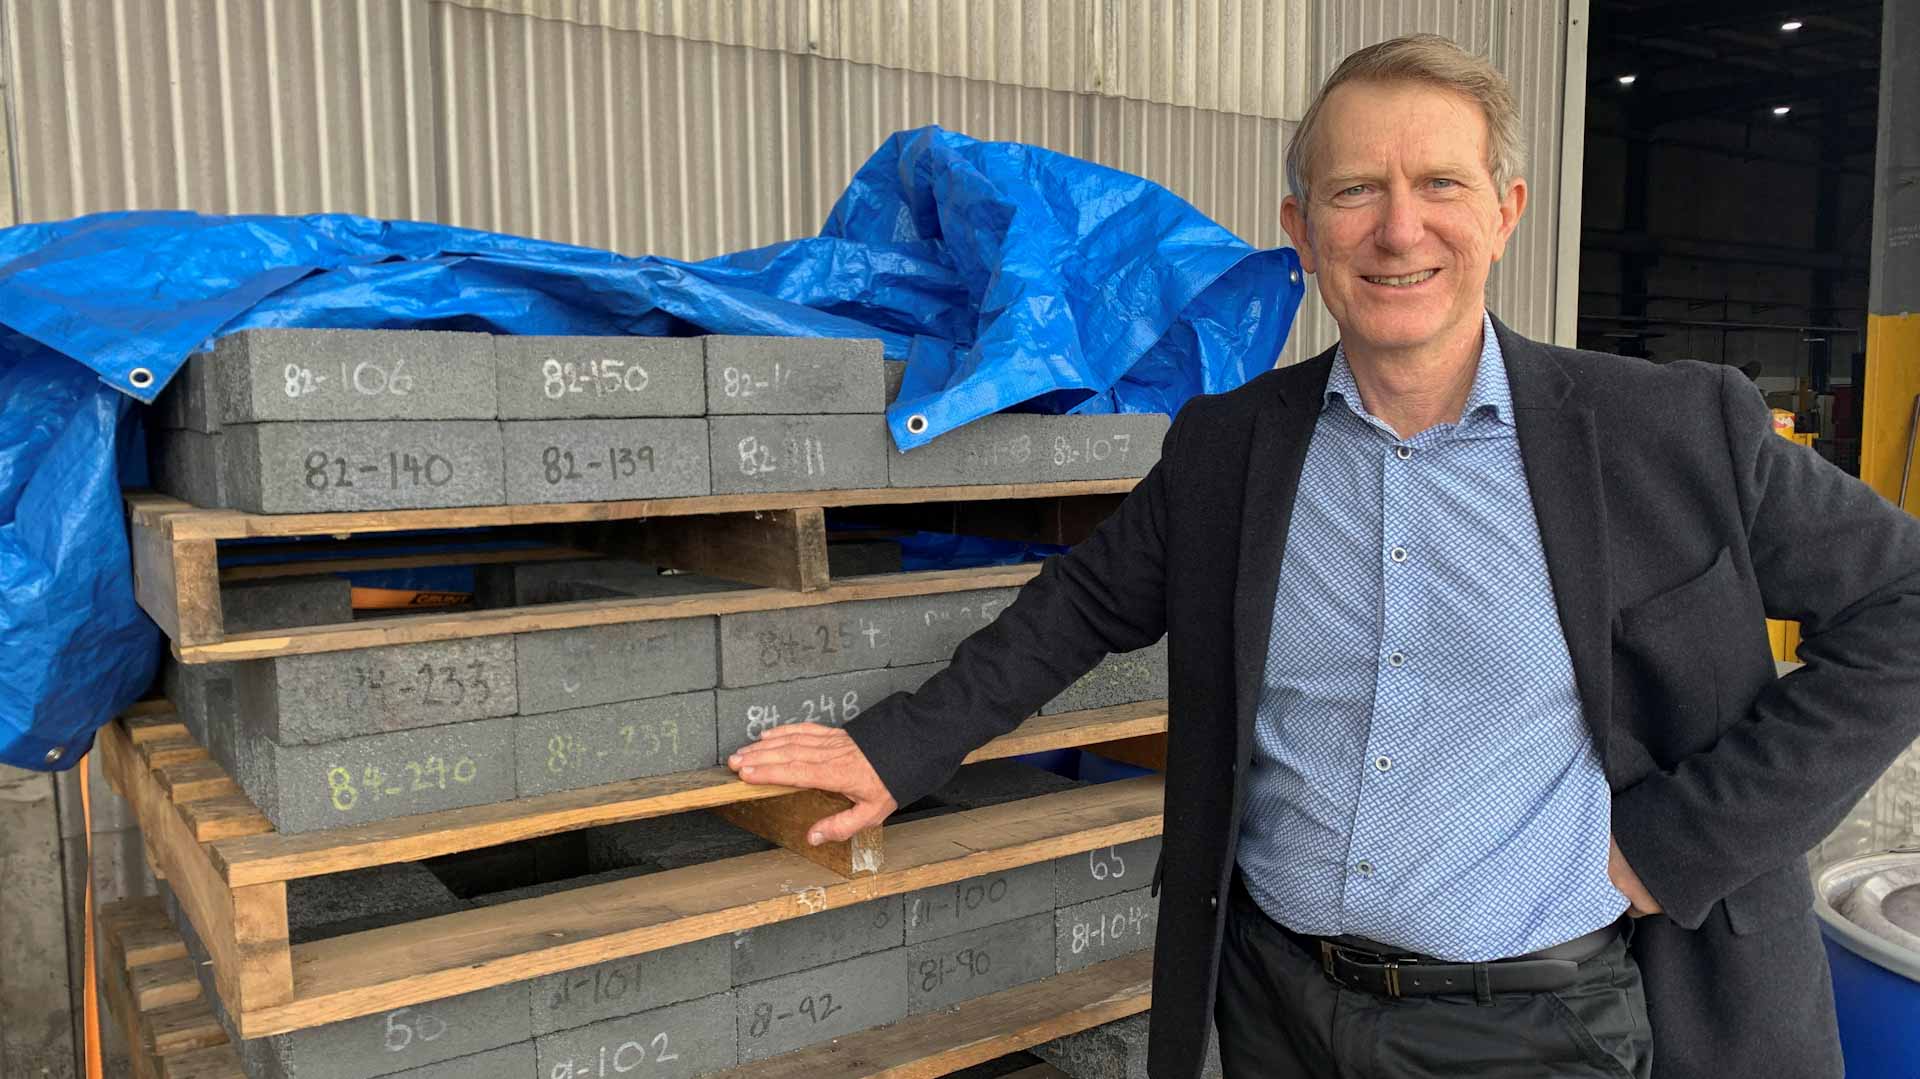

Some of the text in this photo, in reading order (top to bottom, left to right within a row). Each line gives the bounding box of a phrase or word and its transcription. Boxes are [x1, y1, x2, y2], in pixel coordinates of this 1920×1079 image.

[283, 359, 414, 398] 82-106
[542, 358, 650, 400] 82-150
[304, 451, 454, 491] 82-140
[542, 446, 656, 485] 82-139
